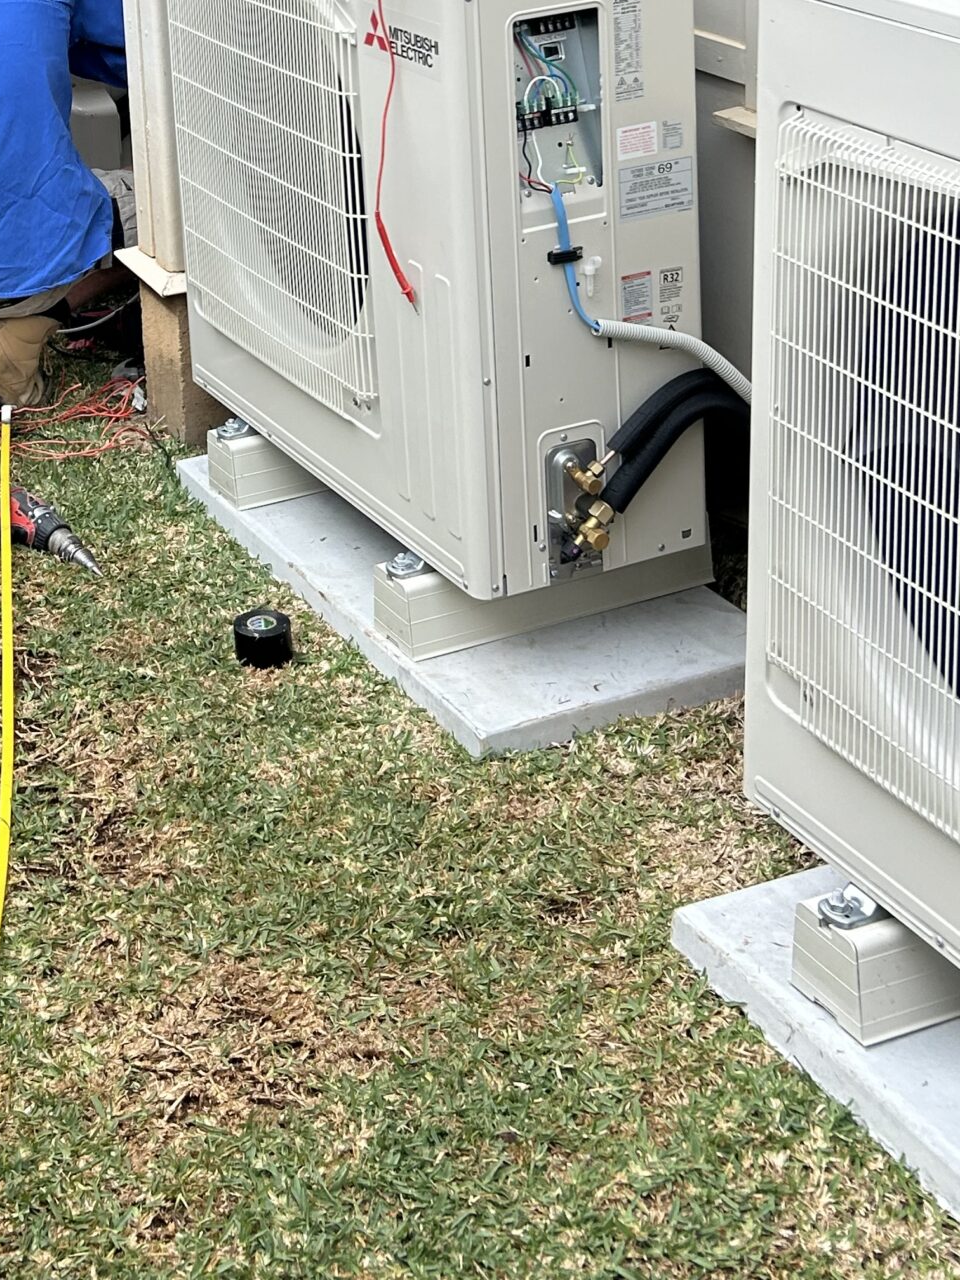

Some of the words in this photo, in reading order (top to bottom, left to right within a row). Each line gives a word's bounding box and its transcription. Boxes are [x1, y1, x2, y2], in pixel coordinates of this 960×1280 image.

[389, 25, 439, 55] MITSUBISHI
[389, 40, 433, 68] ELECTRIC
[657, 162, 673, 174] 69
[662, 272, 680, 284] R32
